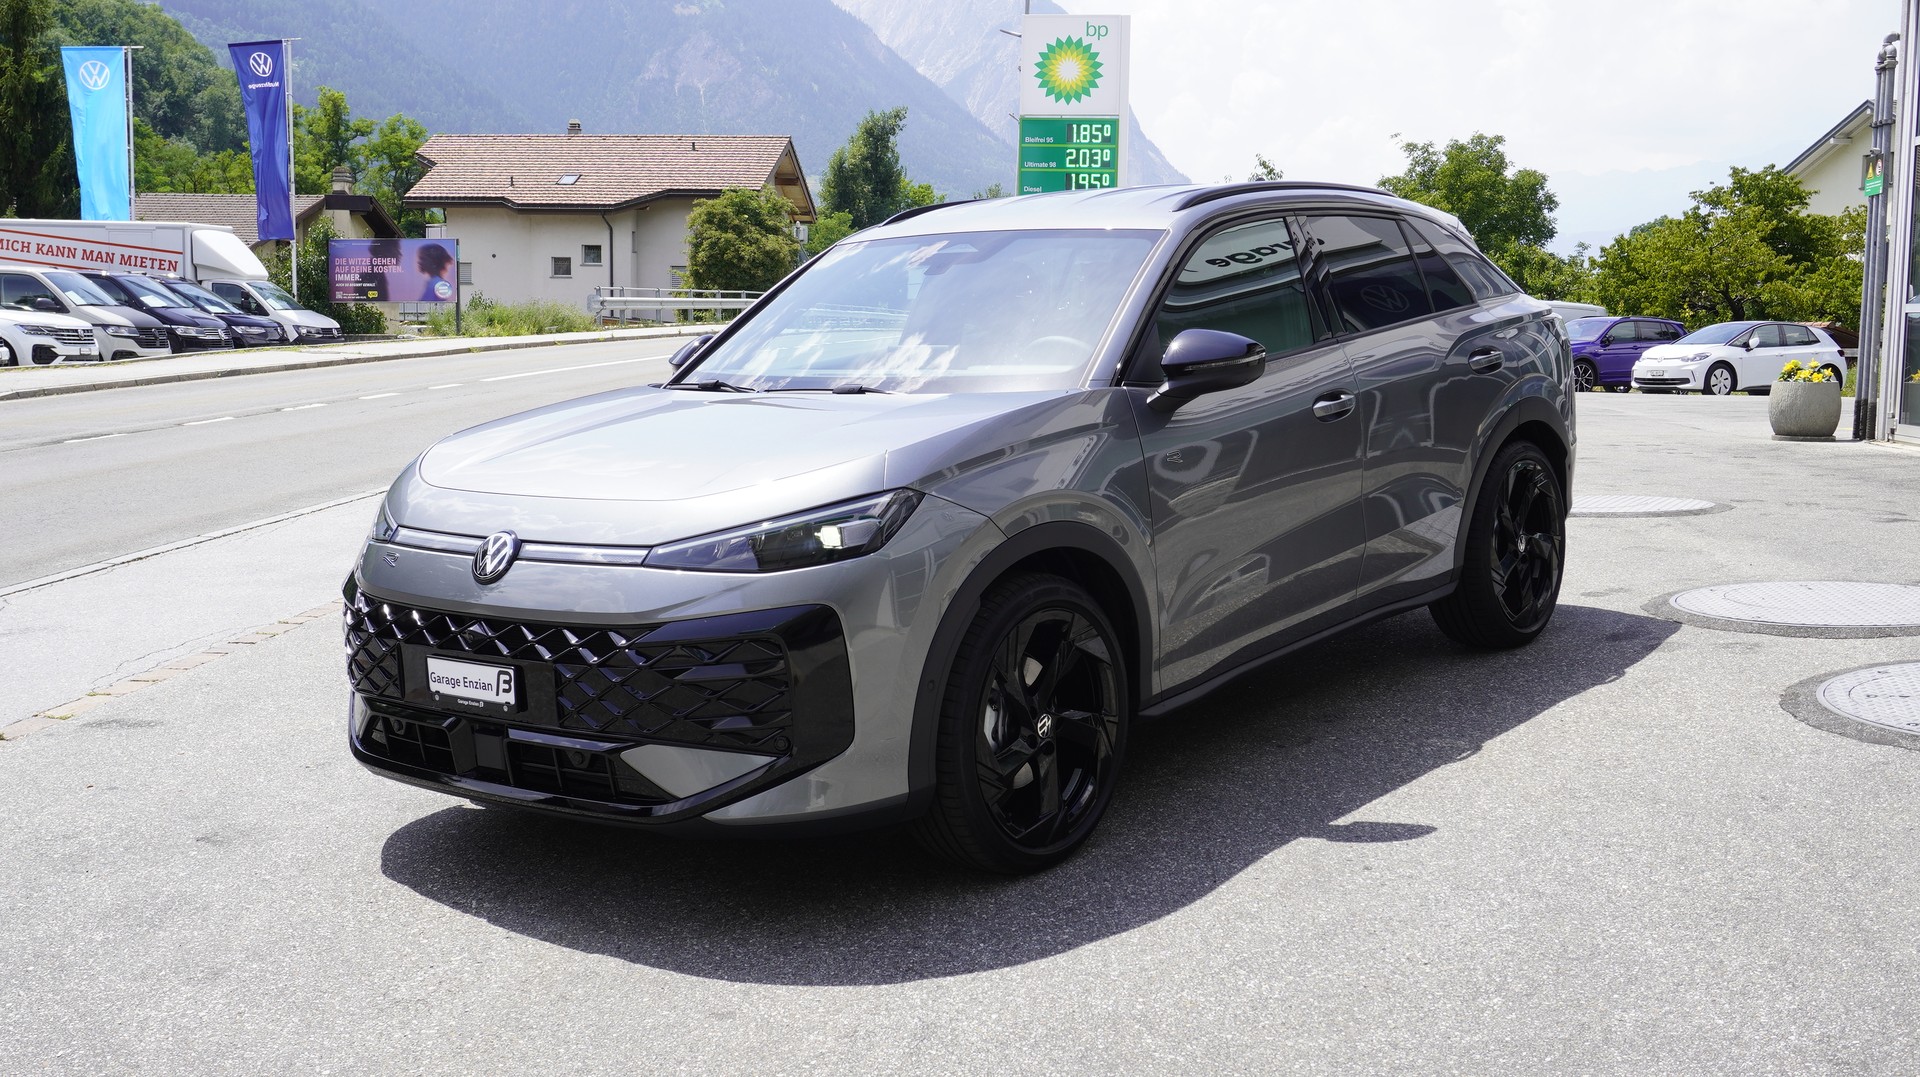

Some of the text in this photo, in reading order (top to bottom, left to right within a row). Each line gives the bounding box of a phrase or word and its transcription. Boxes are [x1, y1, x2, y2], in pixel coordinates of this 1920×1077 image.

[1086, 21, 1109, 41] bp
[36, 243, 78, 259] KANN
[81, 248, 116, 264] MAN
[119, 253, 179, 272] MIETEN
[335, 257, 397, 265] DIE WITZE GEHEN
[335, 265, 404, 273] AUF DEINE KOSTEN.
[335, 273, 362, 281] IMMER.
[430, 671, 461, 689] Garage
[462, 676, 493, 692] Enzian
